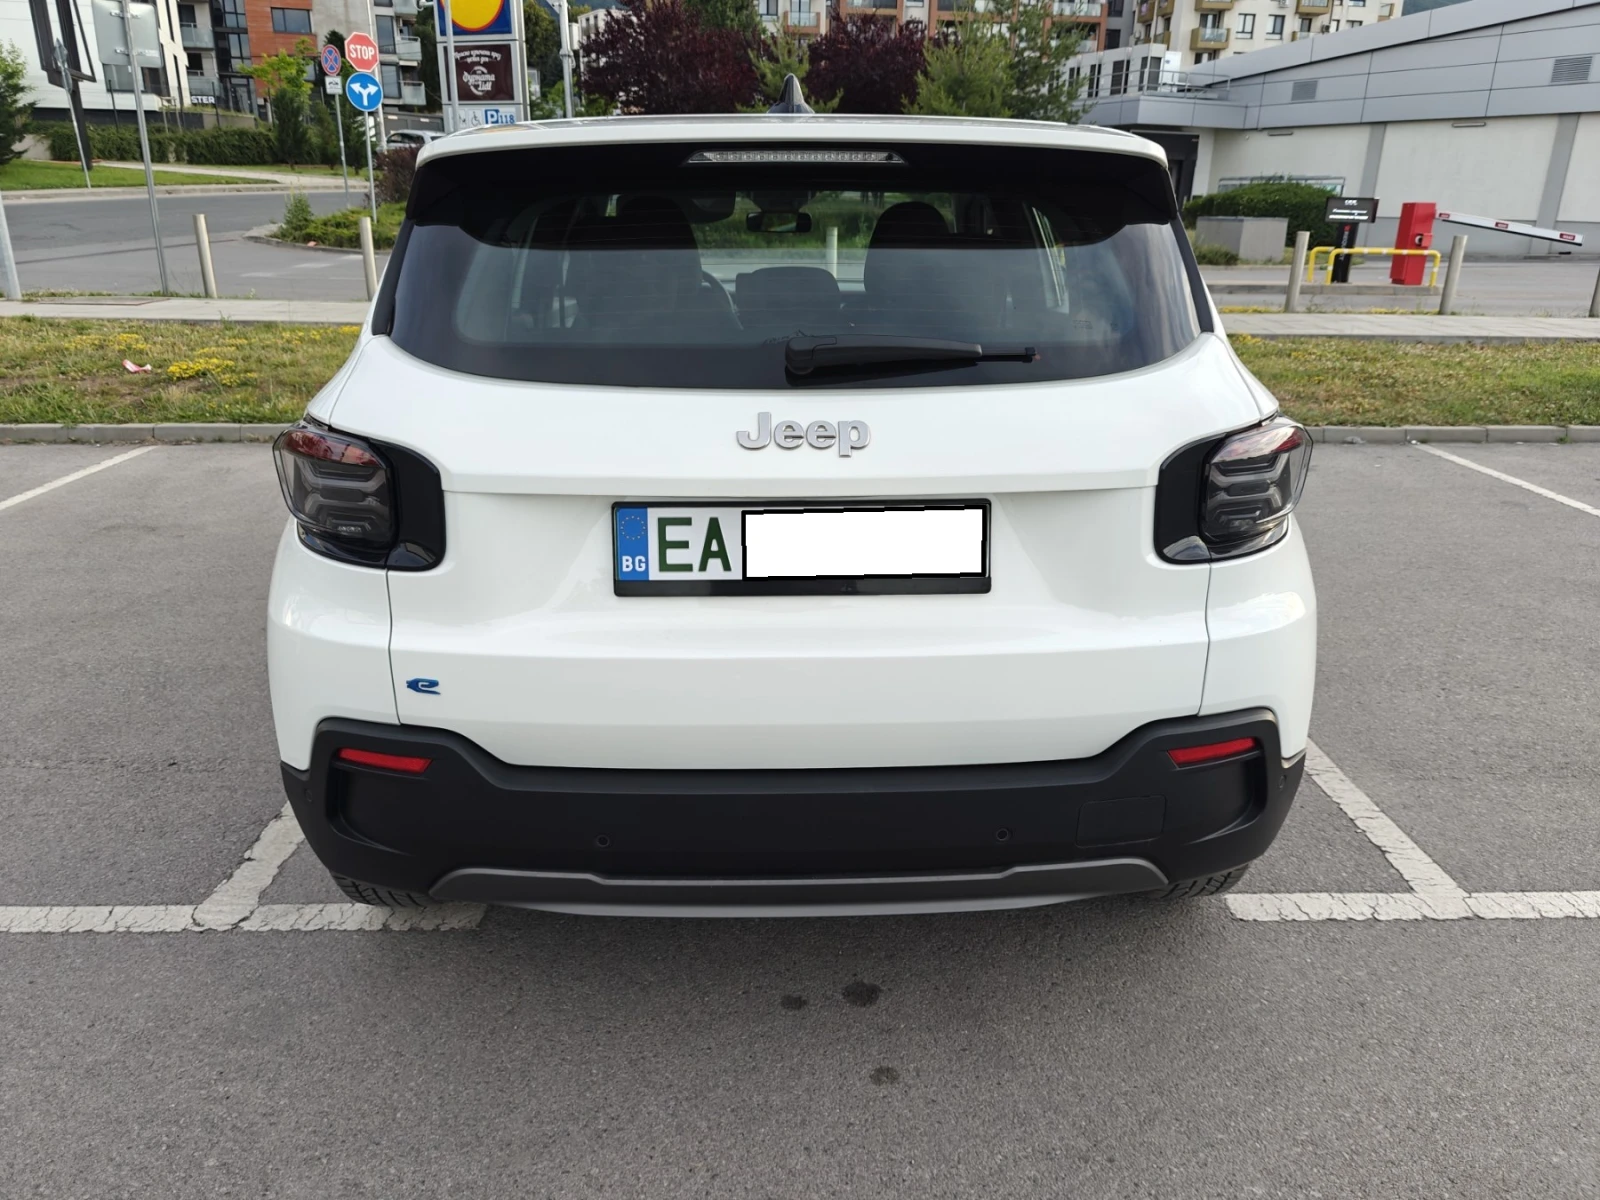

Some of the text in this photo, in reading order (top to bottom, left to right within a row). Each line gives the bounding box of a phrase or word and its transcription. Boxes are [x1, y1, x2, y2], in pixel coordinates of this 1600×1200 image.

[349, 44, 375, 60] STOP
[499, 114, 515, 124] 118
[736, 411, 871, 458] Jeep
[622, 516, 732, 573] BG EA
